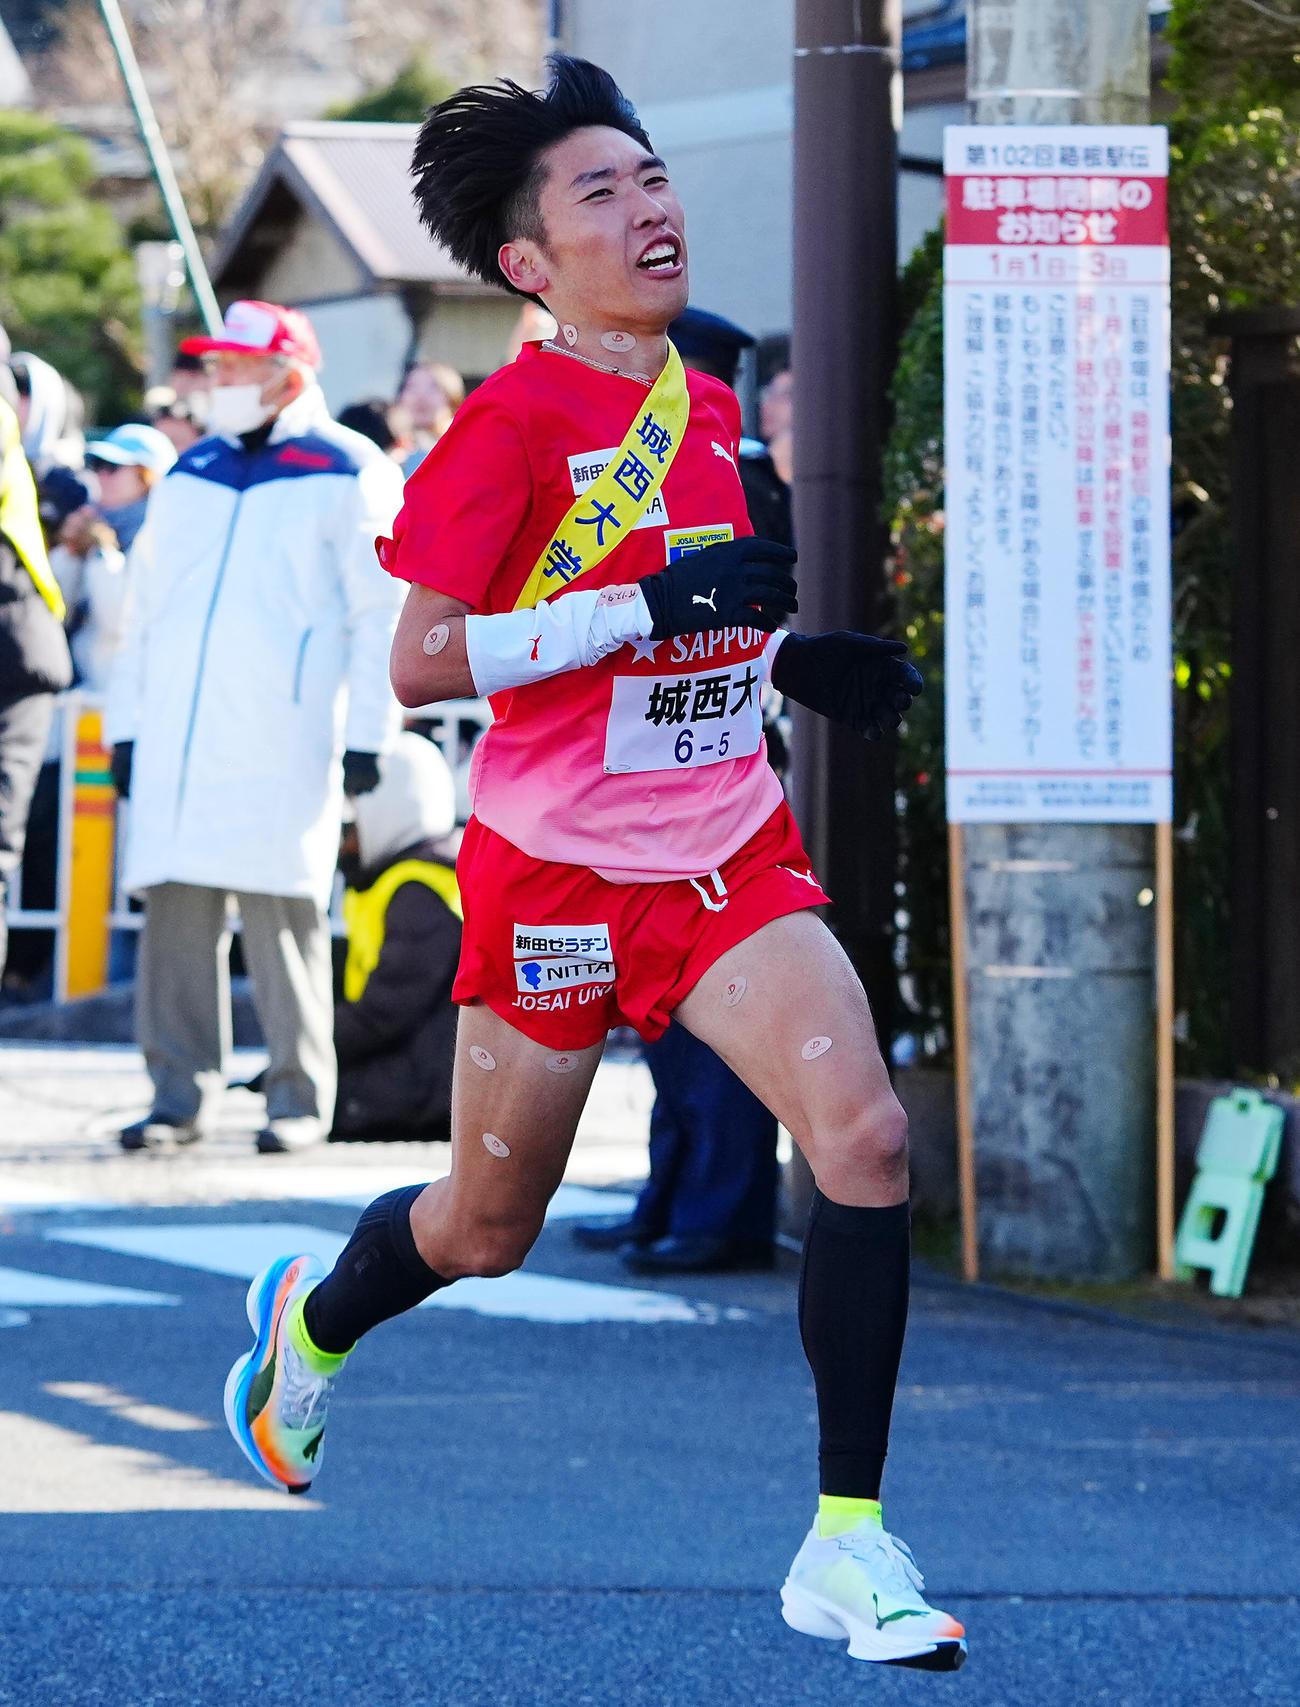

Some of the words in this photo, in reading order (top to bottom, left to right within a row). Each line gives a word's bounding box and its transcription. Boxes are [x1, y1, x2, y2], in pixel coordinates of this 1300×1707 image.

[966, 145, 1150, 168] 第102回箱根駅伝
[996, 211, 1118, 244] お知らせ
[573, 462, 609, 483] 新田
[542, 412, 672, 583] 城西大学
[676, 537, 695, 546] JOSAI
[697, 532, 729, 543] UNIVERSITY
[644, 666, 758, 727] 城西大
[674, 728, 731, 764] 6-5
[515, 934, 608, 953] 新田ゼラチン
[546, 962, 610, 981] NITTA
[511, 991, 572, 1012] JOSAI
